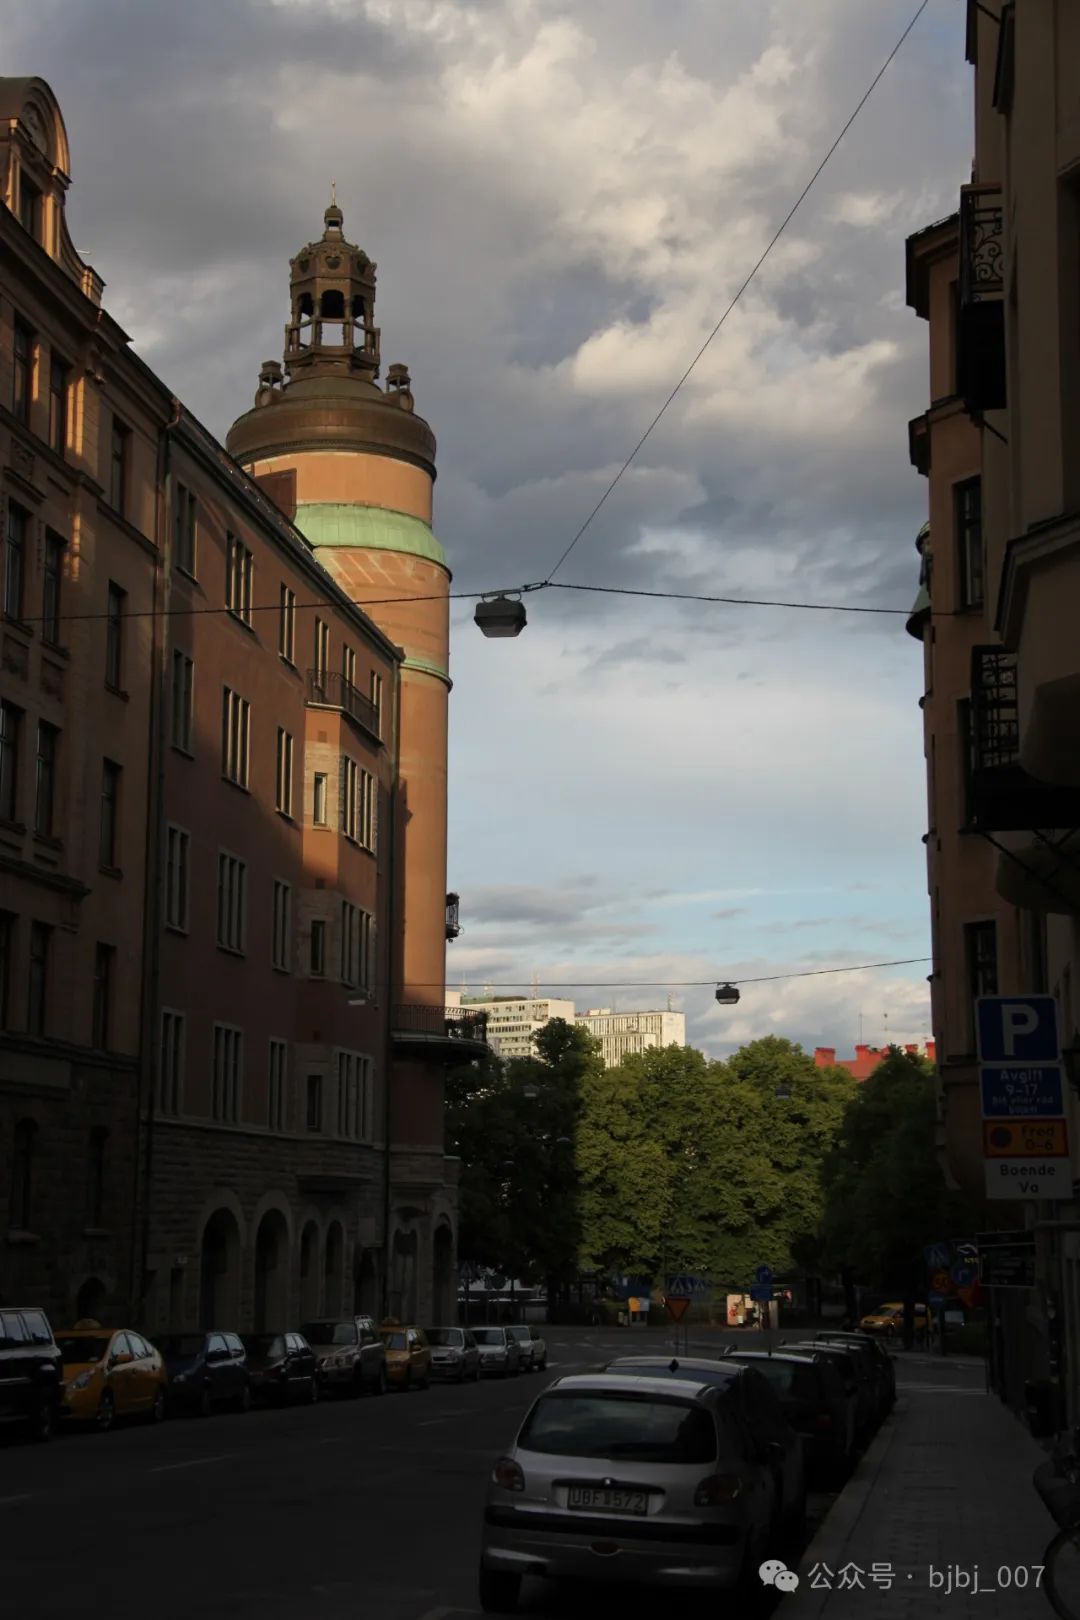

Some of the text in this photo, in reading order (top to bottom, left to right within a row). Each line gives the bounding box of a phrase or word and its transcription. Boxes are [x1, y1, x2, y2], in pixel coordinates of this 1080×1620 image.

[1001, 1003, 1039, 1056] P
[1000, 1069, 1043, 1084] Avgift
[1000, 1163, 1056, 1176] Boende
[1018, 1181, 1039, 1193] Va
